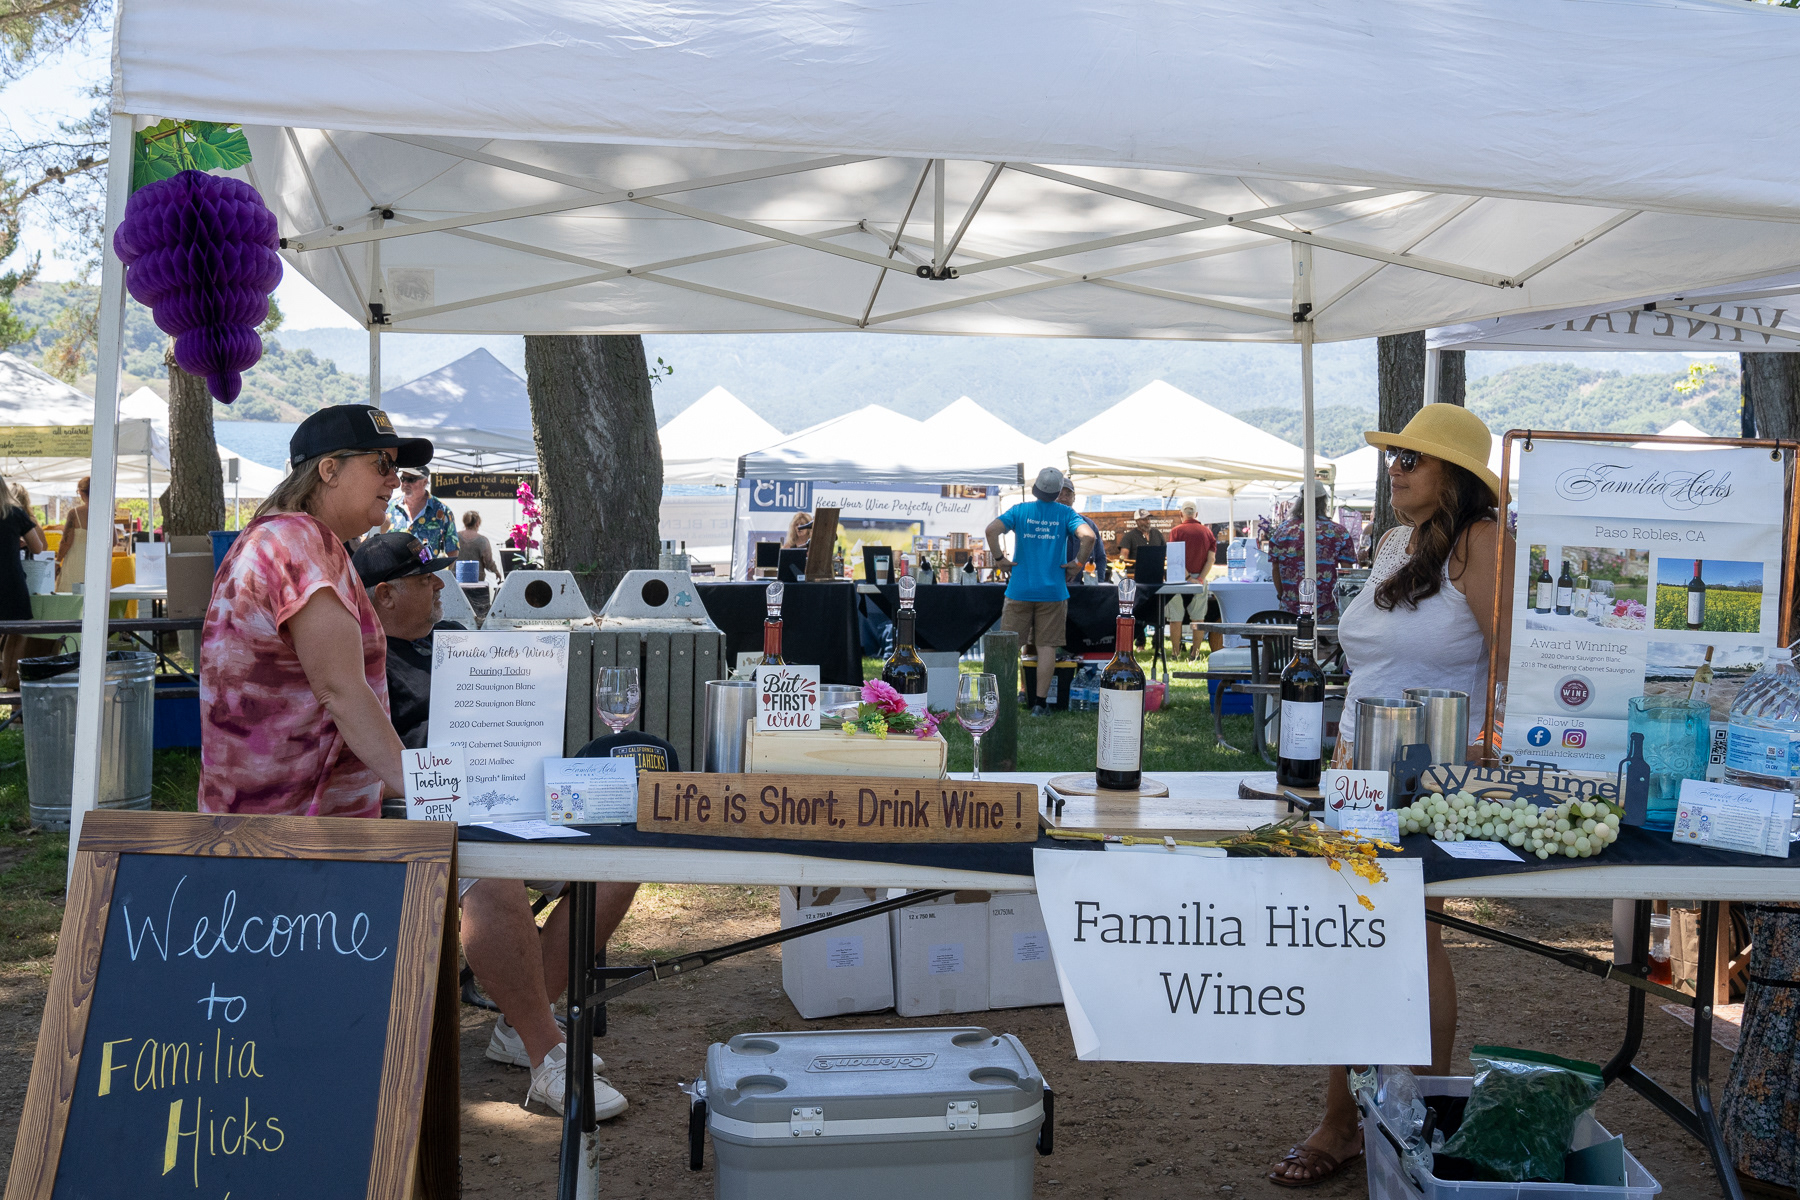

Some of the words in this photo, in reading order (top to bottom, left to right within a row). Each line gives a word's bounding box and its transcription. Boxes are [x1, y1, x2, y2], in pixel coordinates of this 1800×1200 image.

[52, 427, 62, 435] all
[64, 427, 89, 435] natural
[435, 475, 460, 487] Hand
[463, 475, 497, 484] Crafted
[1555, 463, 1668, 501] Familia
[1662, 469, 1735, 511] Hicks
[456, 490, 482, 498] Cheryl
[754, 480, 808, 509] Chill
[816, 497, 838, 509] Keep
[840, 498, 864, 510] Your
[865, 499, 890, 511] Wine
[892, 500, 933, 515] Perfectly
[936, 502, 972, 513] Chilled!
[1595, 526, 1629, 539] Paso
[1632, 528, 1681, 542] Robles,
[1685, 530, 1706, 542] CA
[447, 645, 487, 659] Familia
[489, 645, 520, 659] Hicks
[522, 646, 555, 659] Wines
[1530, 638, 1571, 650] Award
[1575, 640, 1628, 655] Winning
[469, 667, 503, 676] Pouring
[503, 667, 531, 676] Today
[1548, 663, 1577, 672] Gathering
[1578, 665, 1605, 673] Cabernet
[456, 683, 474, 691] 2021
[475, 683, 514, 692] Sauvignon
[763, 674, 803, 693] But
[1562, 689, 1588, 698] WINE
[454, 700, 474, 708] 2022
[475, 700, 514, 708] Sauvignon
[515, 699, 536, 707] Blanc
[771, 694, 808, 711] FIRST
[449, 720, 470, 729] 2020
[471, 720, 505, 728] Cabernet
[506, 719, 544, 727] Sauvignon
[767, 712, 812, 727] wine
[1536, 717, 1568, 728] Follow
[1571, 720, 1585, 728] Us
[468, 740, 502, 748] Cabernet
[503, 740, 542, 748] Sauvignon
[415, 751, 452, 770] Wine
[1514, 748, 1606, 760] @familiahickswines
[409, 770, 461, 792] Tasting
[1335, 775, 1385, 802] Wine
[425, 803, 452, 814] OPEN
[652, 783, 711, 823] Life
[723, 785, 747, 824] is
[759, 785, 846, 829] Short,
[858, 788, 930, 828] Drink
[942, 790, 1004, 829] Wine
[1016, 791, 1022, 830] !
[425, 813, 453, 821] DAILY
[123, 875, 387, 962] Welcome
[992, 908, 1014, 916] 12X750ML
[1073, 900, 1246, 947] Familia
[1265, 904, 1386, 948] Hicks
[1159, 971, 1306, 1016] Wines
[197, 982, 247, 1023] to
[98, 1028, 264, 1097] Familia
[835, 1057, 928, 1068] Coleman
[162, 1096, 285, 1188] Hicks
